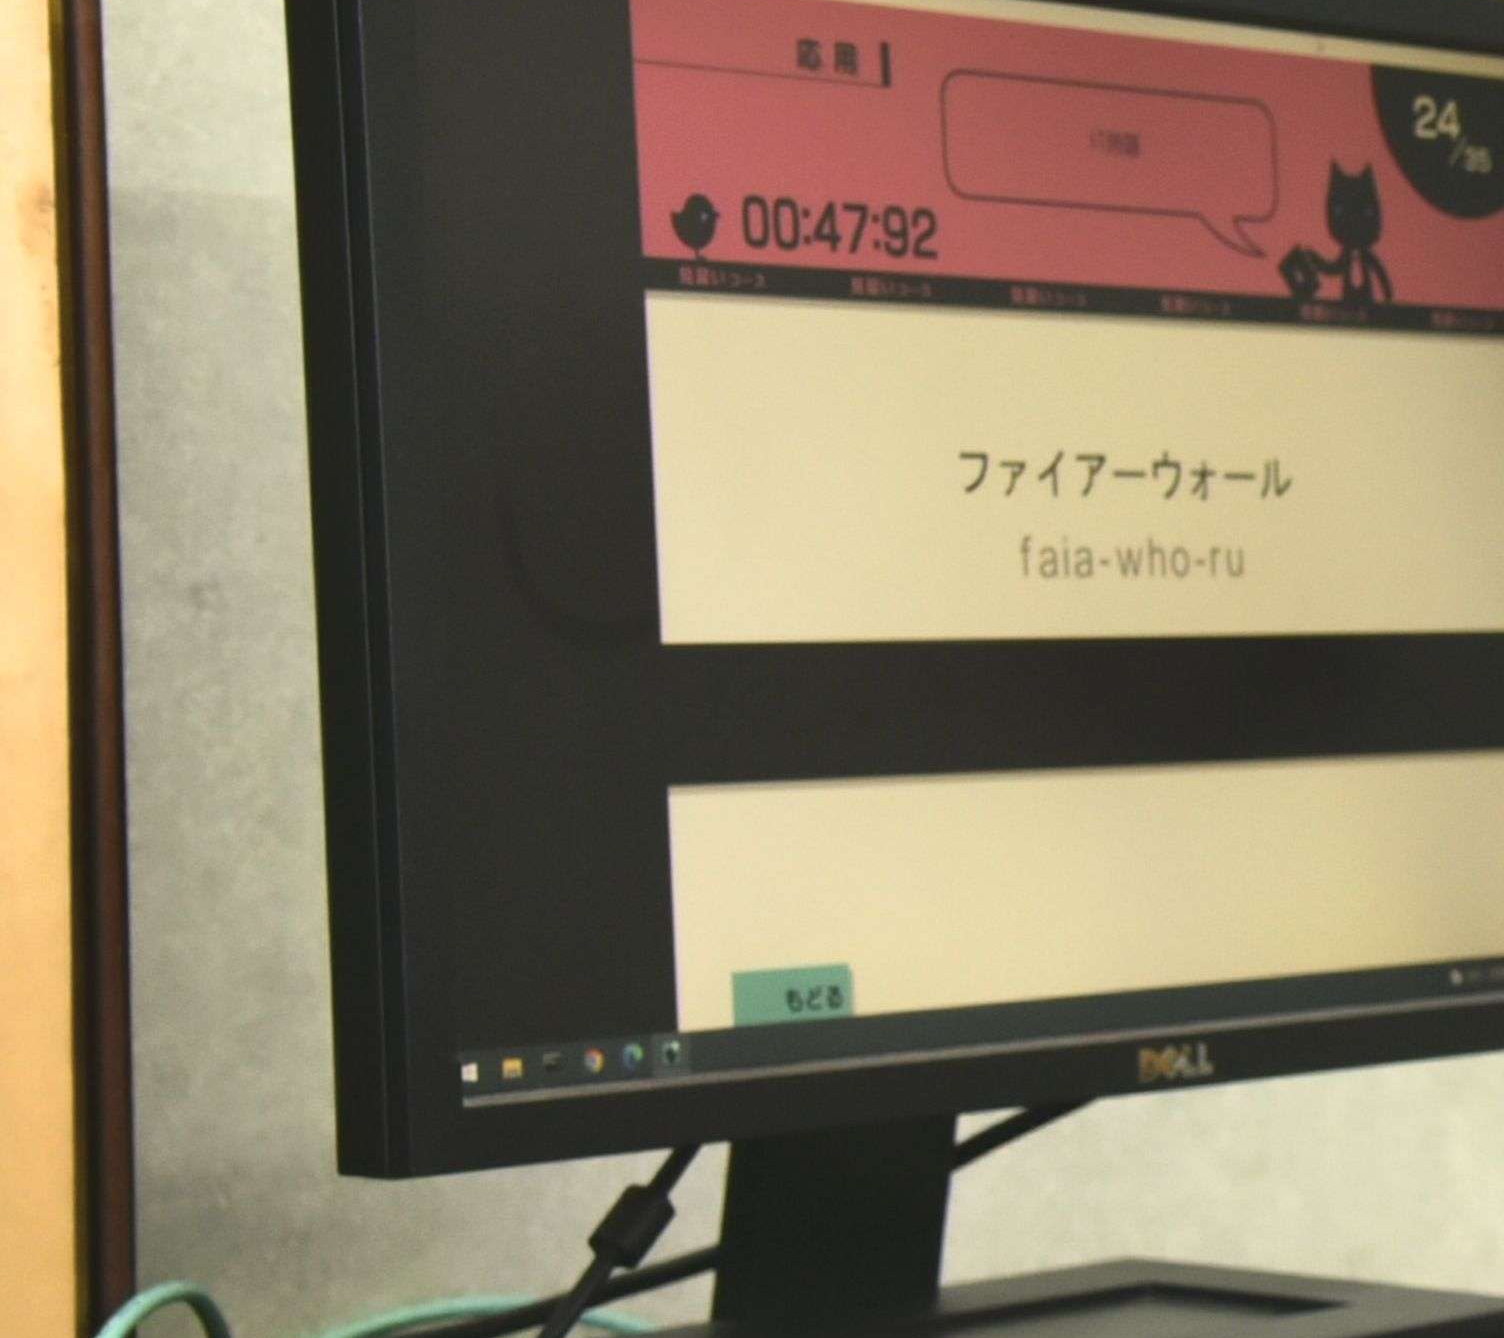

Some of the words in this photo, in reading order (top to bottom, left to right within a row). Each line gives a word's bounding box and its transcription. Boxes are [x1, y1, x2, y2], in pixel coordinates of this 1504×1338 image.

[1413, 94, 1461, 140] 24
[741, 193, 939, 261] 00:47:92
[958, 450, 1292, 500] ファイアーウォール
[1019, 534, 1246, 579] faia-who-ru
